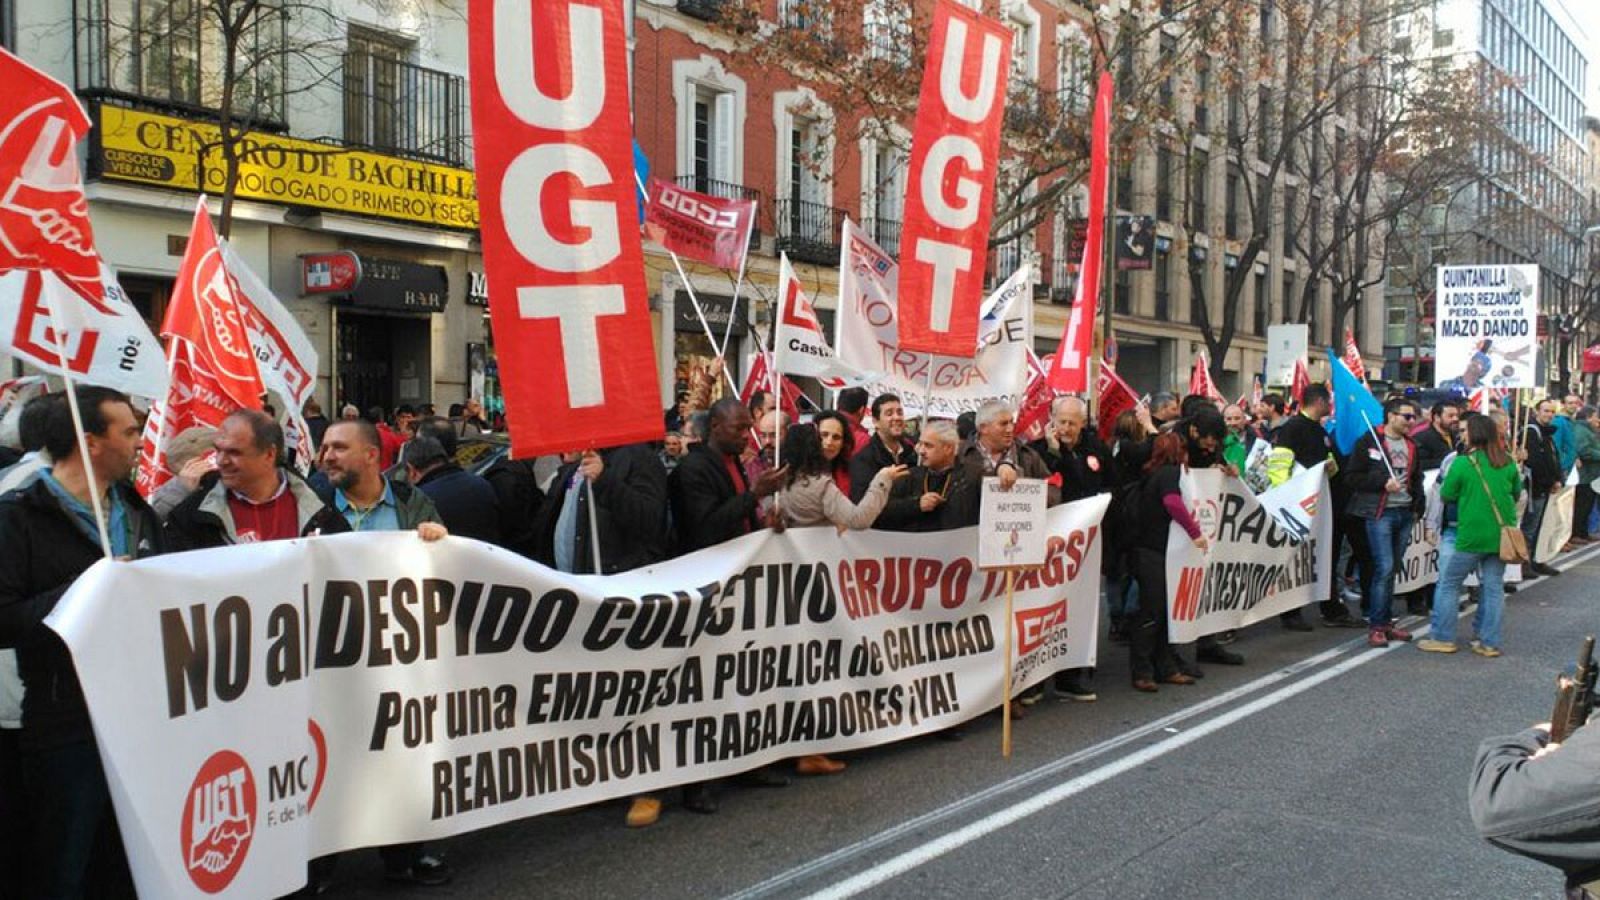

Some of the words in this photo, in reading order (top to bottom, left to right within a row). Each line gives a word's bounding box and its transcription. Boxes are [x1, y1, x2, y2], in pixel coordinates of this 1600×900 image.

[104, 149, 149, 166] CURSOS
[151, 155, 166, 168] DE
[111, 161, 161, 179] VERANO
[136, 120, 287, 170] CENRO
[297, 150, 338, 178] DE
[347, 156, 477, 201] BACHILL
[915, 16, 1001, 333] UGT
[352, 189, 425, 217] PRIMERO
[493, 0, 627, 409] UGT
[1443, 267, 1506, 288] QUINTANILLA
[404, 290, 440, 307] BAR
[1443, 293, 1451, 306] A
[1452, 292, 1475, 306] DIOS
[1476, 289, 1522, 306] REZANDO
[1489, 309, 1511, 317] con
[1513, 307, 1525, 317] el
[1441, 319, 1480, 337] MAZO
[1482, 319, 1529, 337] DANDO
[788, 338, 833, 358] Cast
[877, 340, 988, 388] TRAGSA
[1172, 567, 1203, 621] NO
[160, 595, 252, 719] NO
[266, 583, 310, 688] al
[313, 577, 580, 669] DESPIDO
[582, 562, 837, 652] COLECTIVO
[838, 556, 974, 621] GRUPO
[369, 691, 438, 751] Por
[447, 684, 516, 740] una
[527, 656, 703, 725] EMPRESA
[714, 640, 842, 700] PÚBLICA
[847, 636, 883, 678] de
[883, 613, 995, 673] CALIDAD
[431, 721, 661, 821] READMISIÓN
[670, 684, 905, 769] TRABAJADORES
[193, 766, 250, 826] UGT
[280, 807, 295, 823] de
